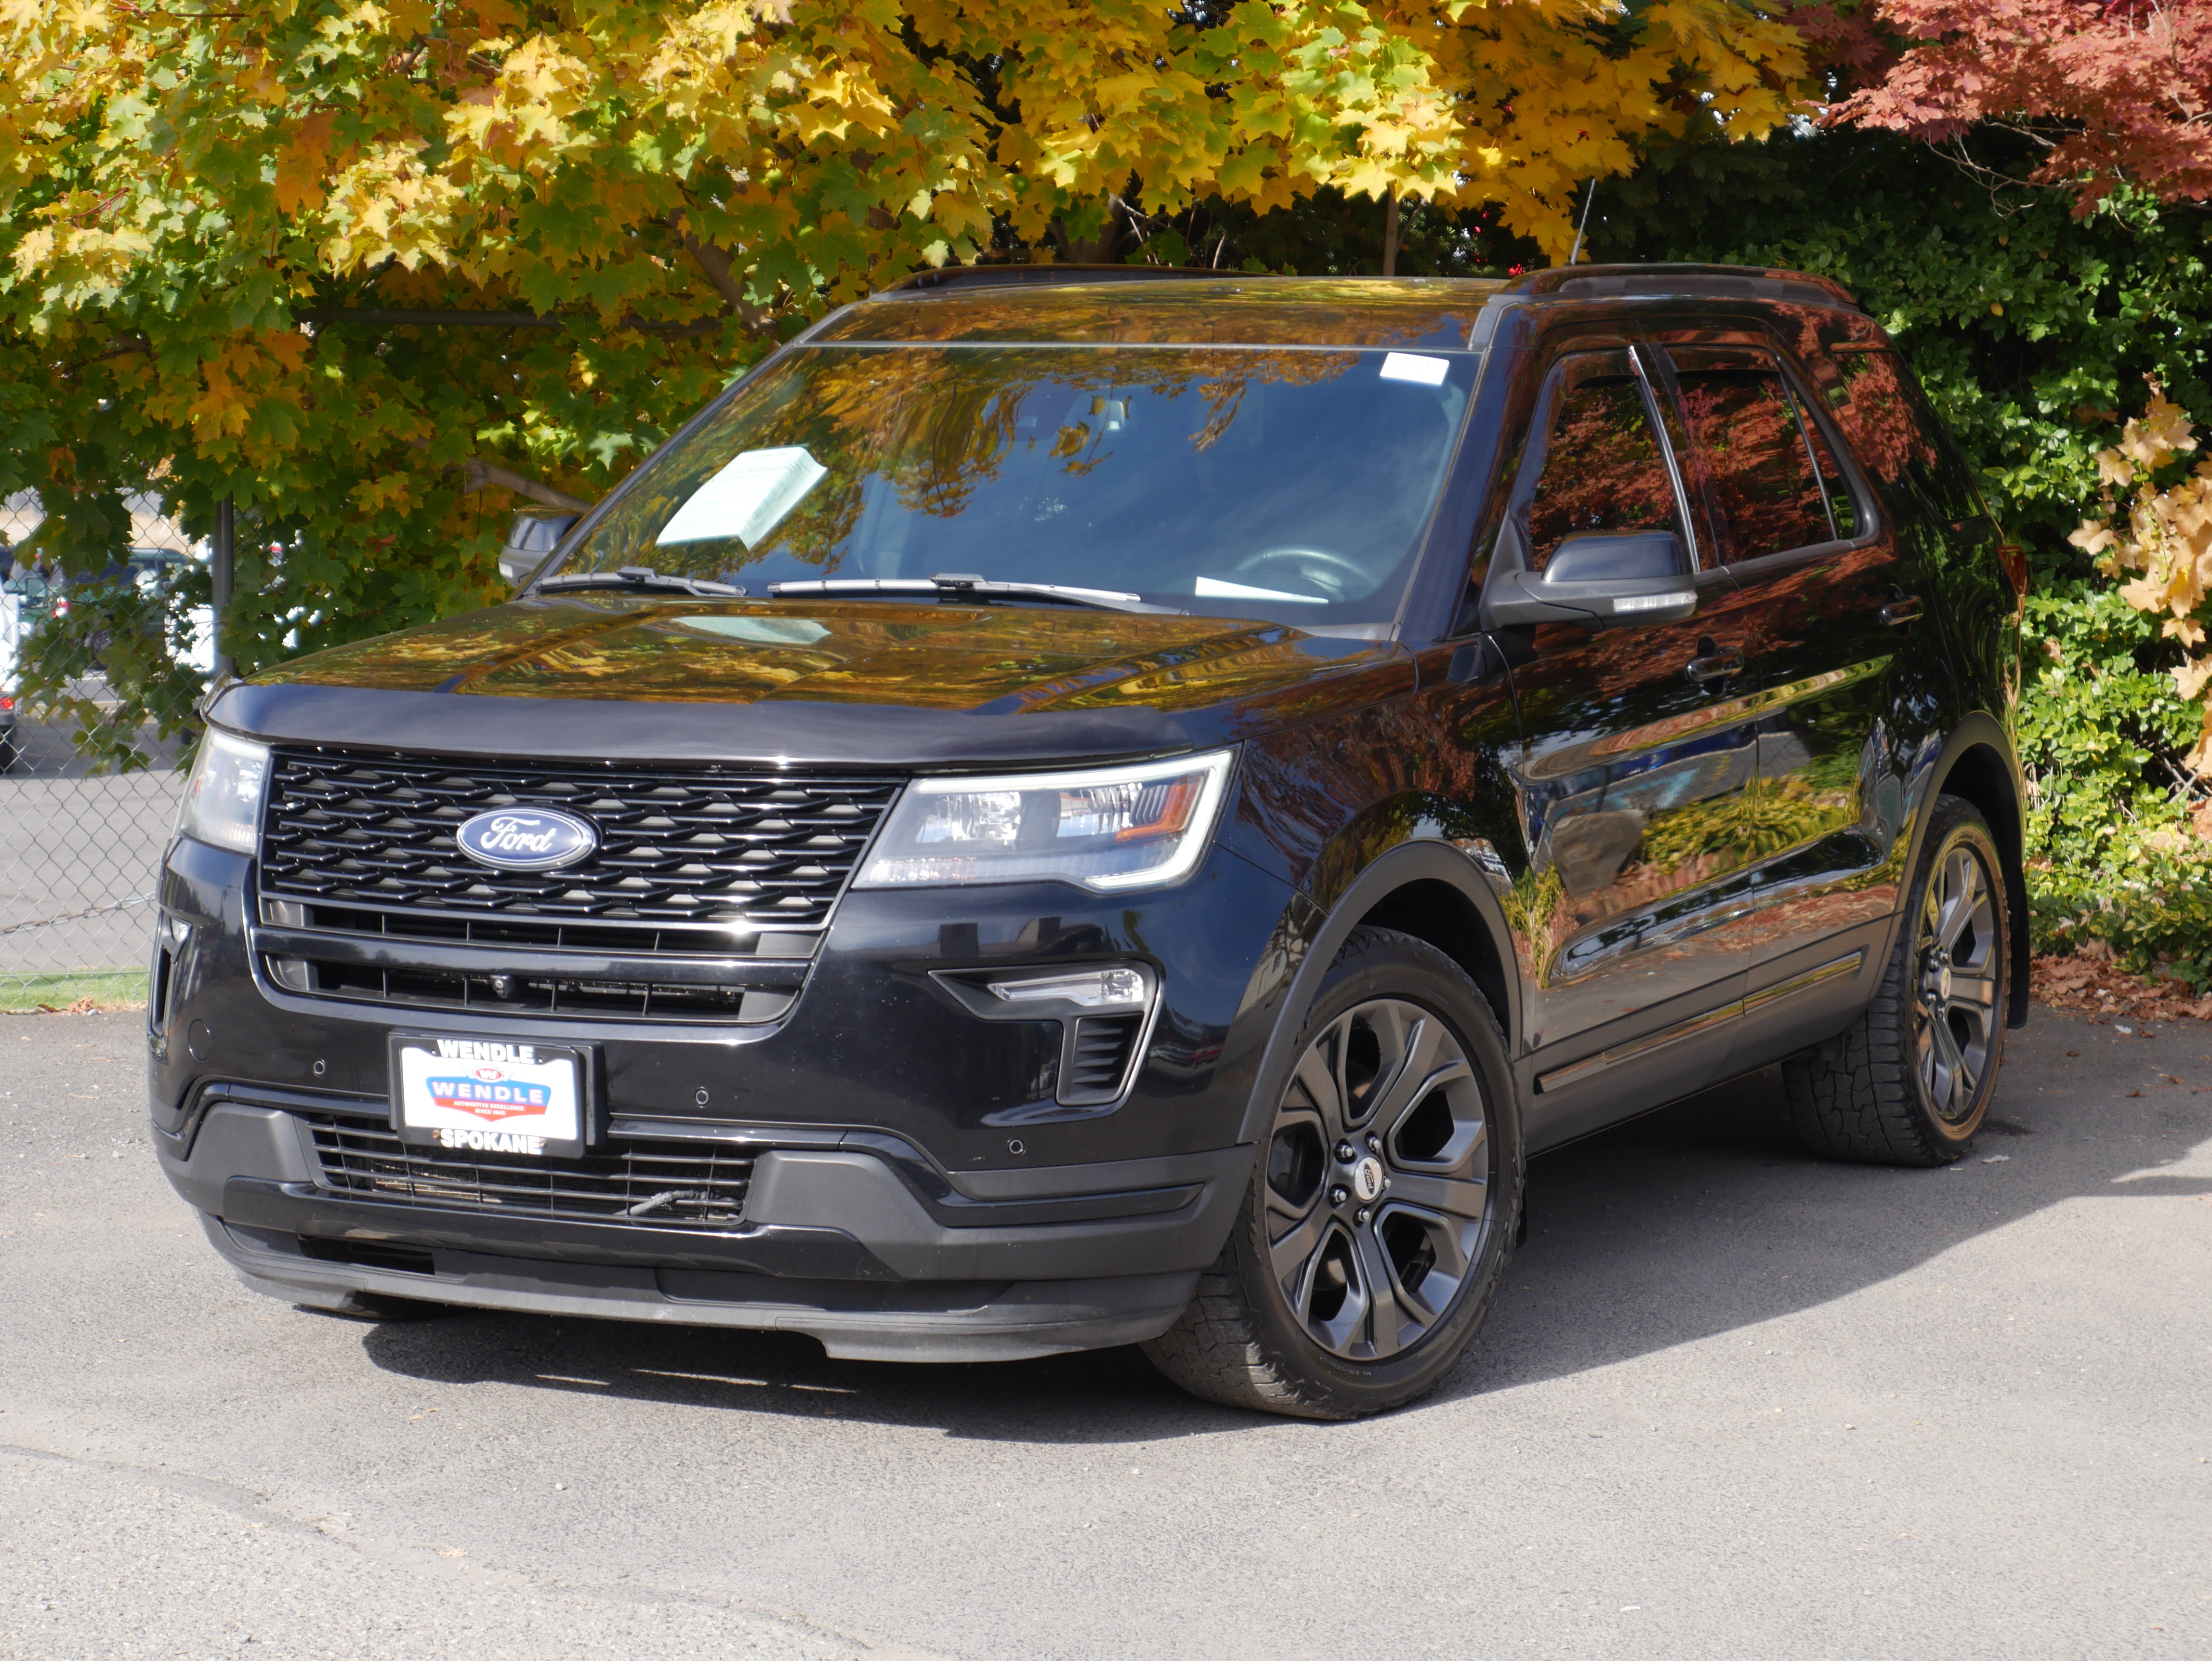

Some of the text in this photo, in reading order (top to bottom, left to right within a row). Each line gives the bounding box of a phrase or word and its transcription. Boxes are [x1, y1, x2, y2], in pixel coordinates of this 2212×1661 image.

[480, 817, 556, 852] Ford
[437, 1040, 534, 1065] WENDLE
[478, 1069, 498, 1080] W
[432, 1081, 542, 1104] WENDLE
[490, 1103, 524, 1111] EXCELLENCE
[440, 1129, 541, 1155] SPOKANE
[1365, 1168, 1374, 1190] Ford
